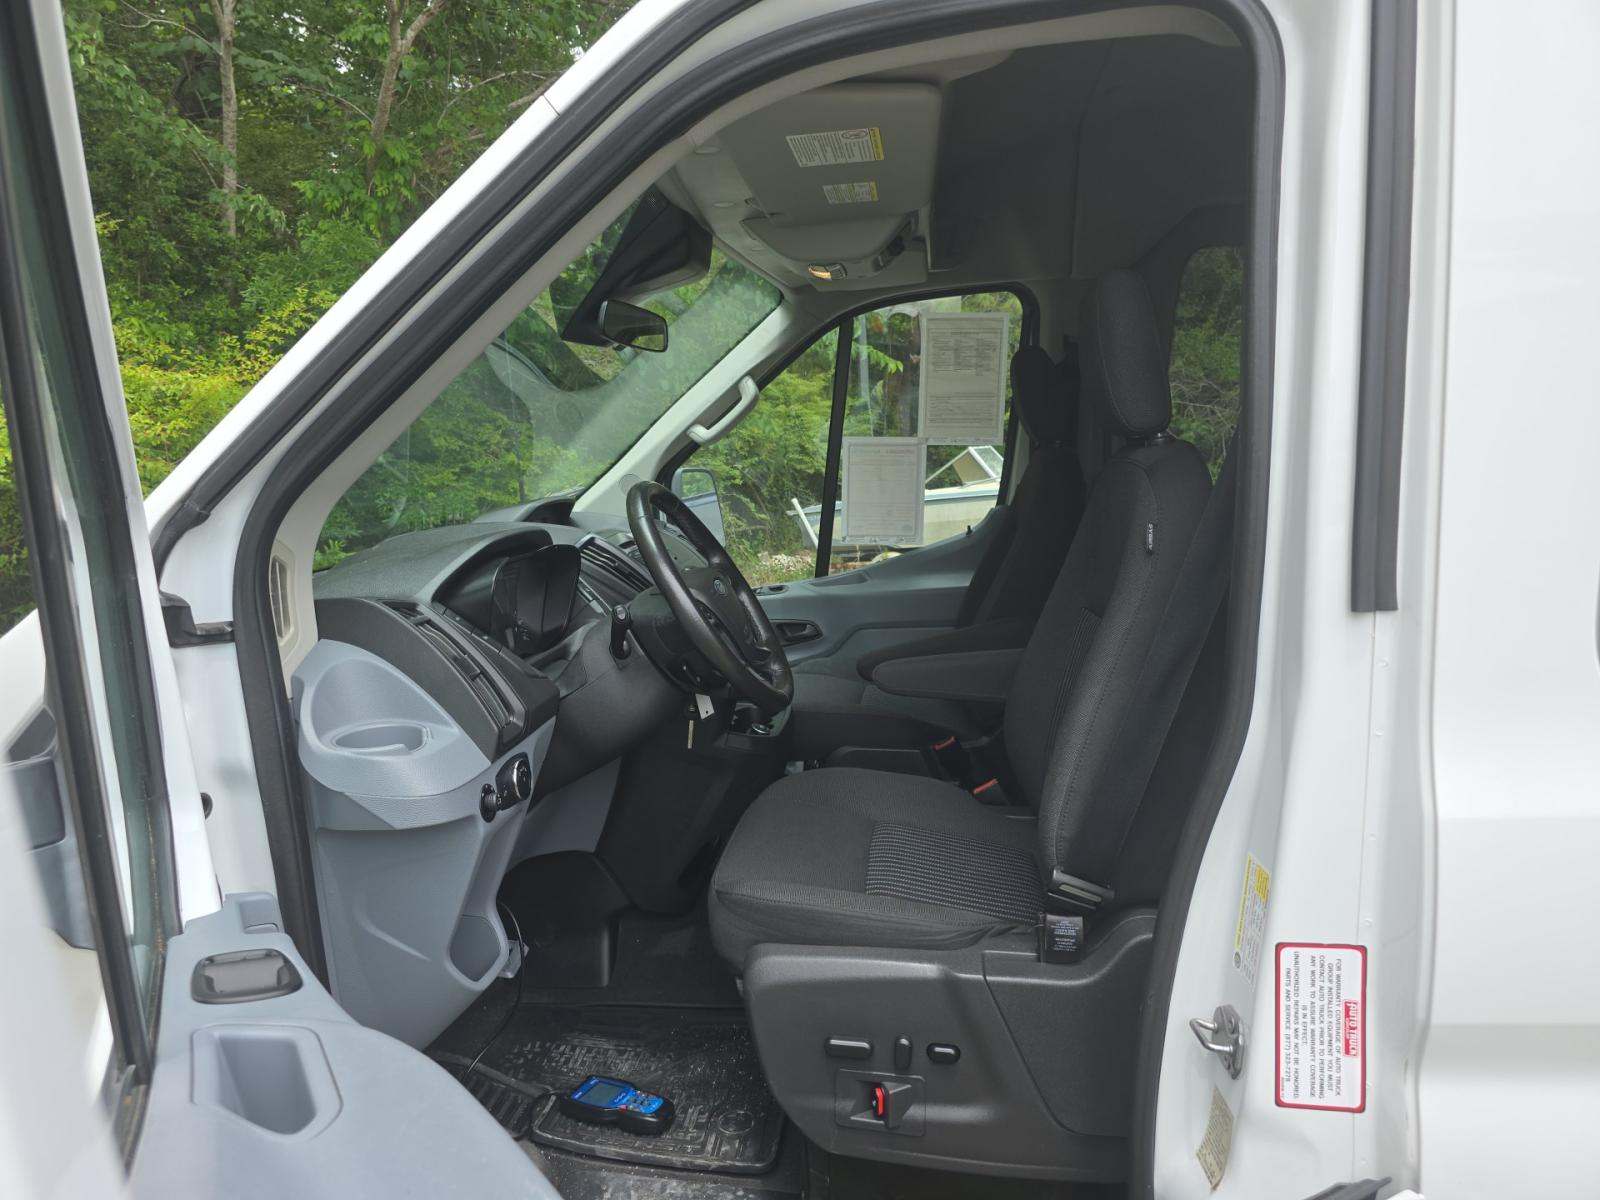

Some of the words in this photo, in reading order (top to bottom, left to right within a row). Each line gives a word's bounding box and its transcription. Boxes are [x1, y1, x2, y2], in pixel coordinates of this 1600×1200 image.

[1349, 1029, 1357, 1056] TRUCK
[1319, 1048, 1324, 1056] TO
[1335, 1045, 1341, 1054] OF
[1293, 1058, 1299, 1066] BE
